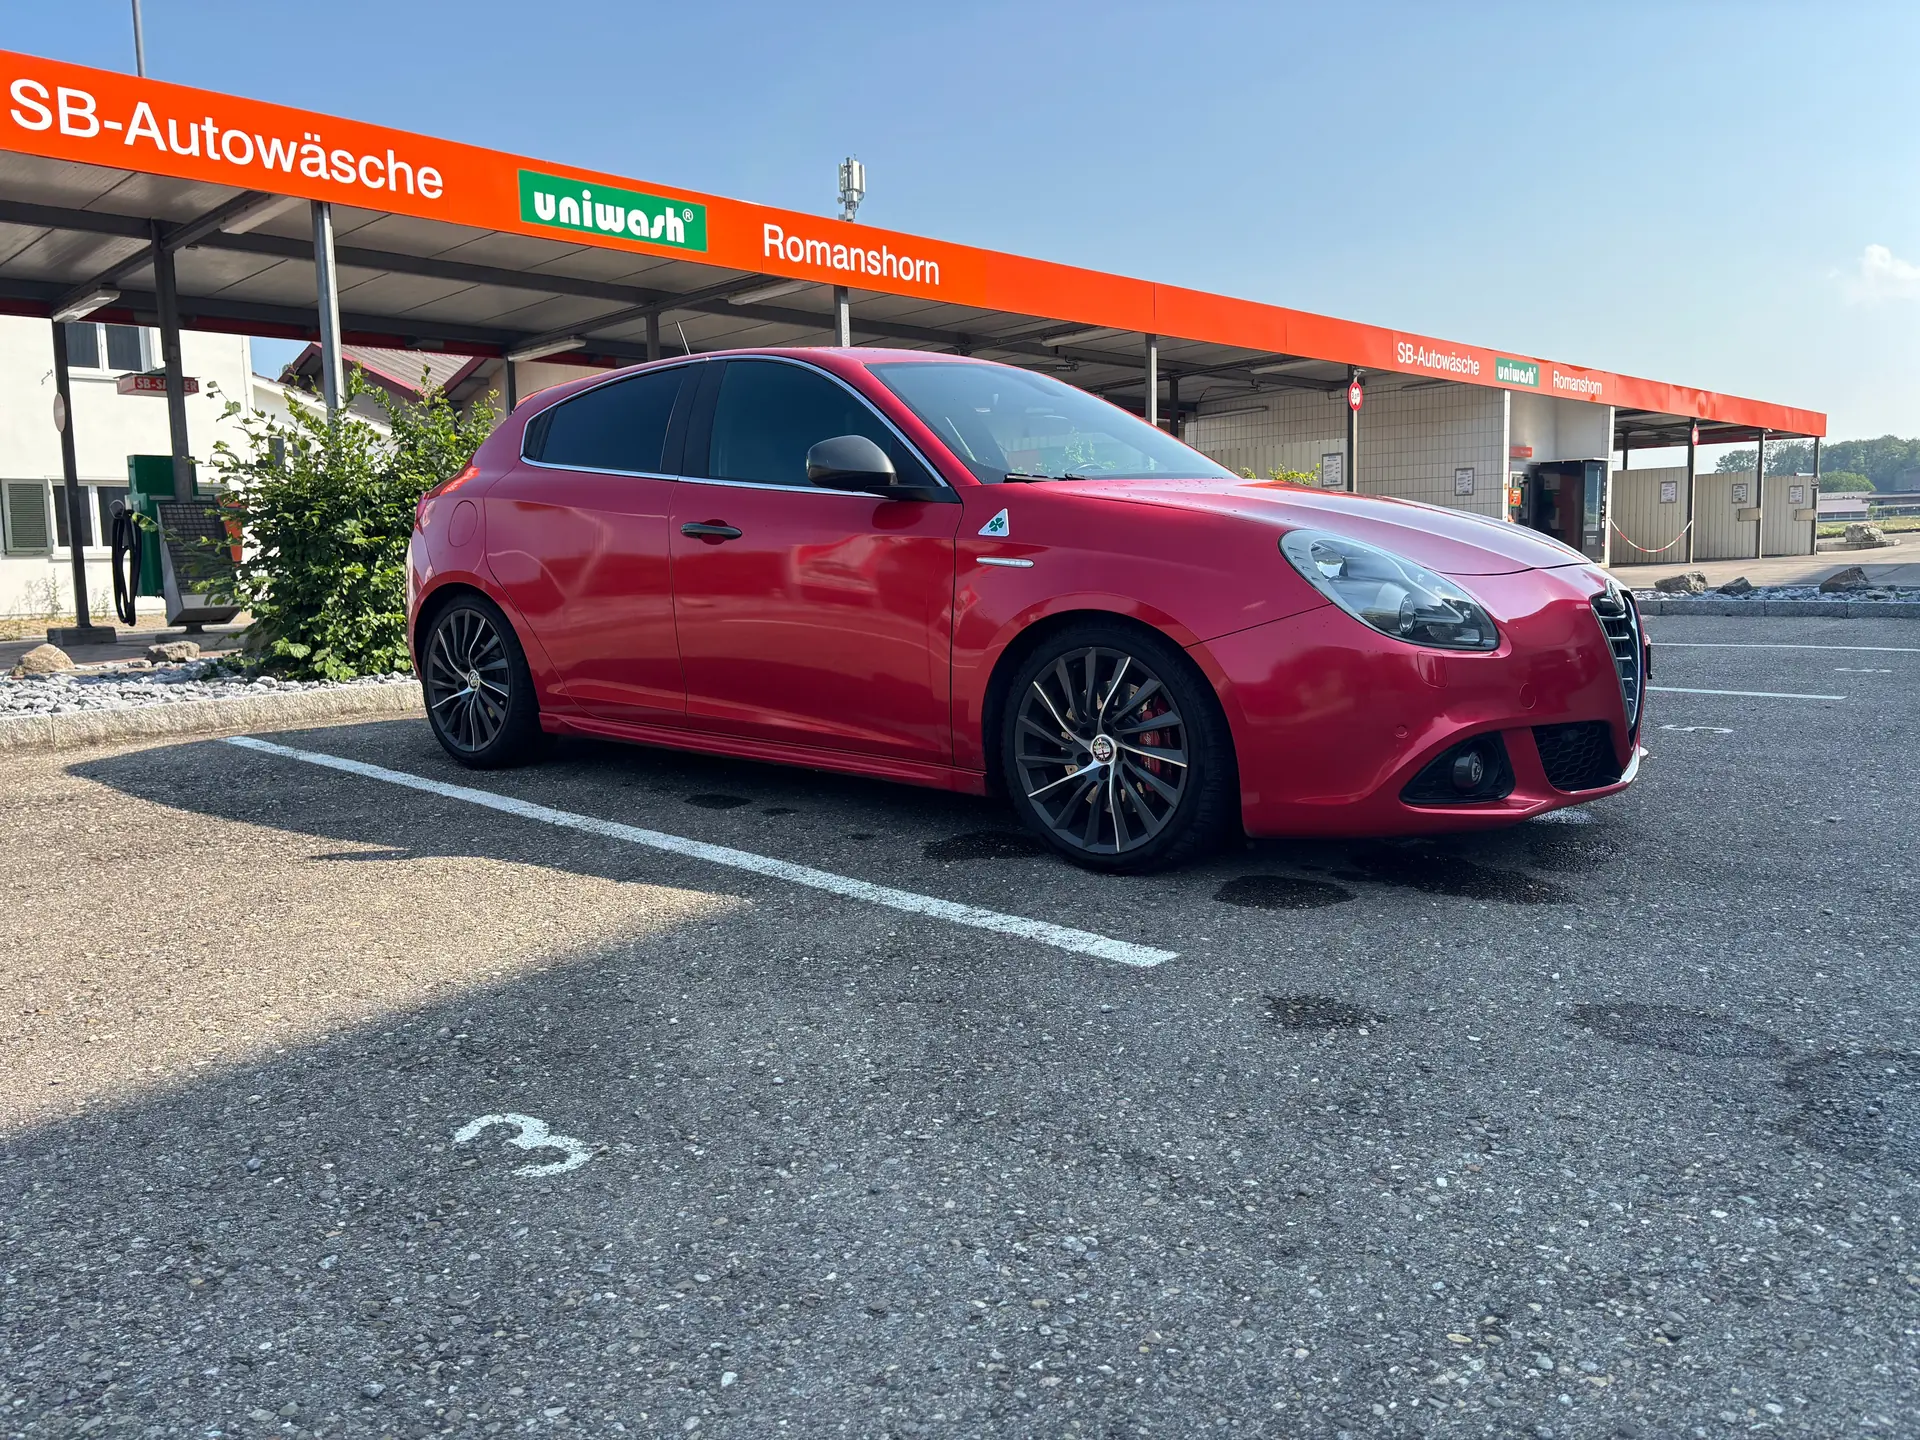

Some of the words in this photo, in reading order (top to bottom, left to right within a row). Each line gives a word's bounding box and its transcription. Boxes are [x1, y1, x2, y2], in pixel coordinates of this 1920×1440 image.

[9, 78, 444, 199] SB-Autowäsche
[763, 223, 940, 285] Romanshorn
[1397, 342, 1480, 376] SB-Autowäsche
[1553, 370, 1602, 395] Romanshorn
[454, 1112, 593, 1177] 3
